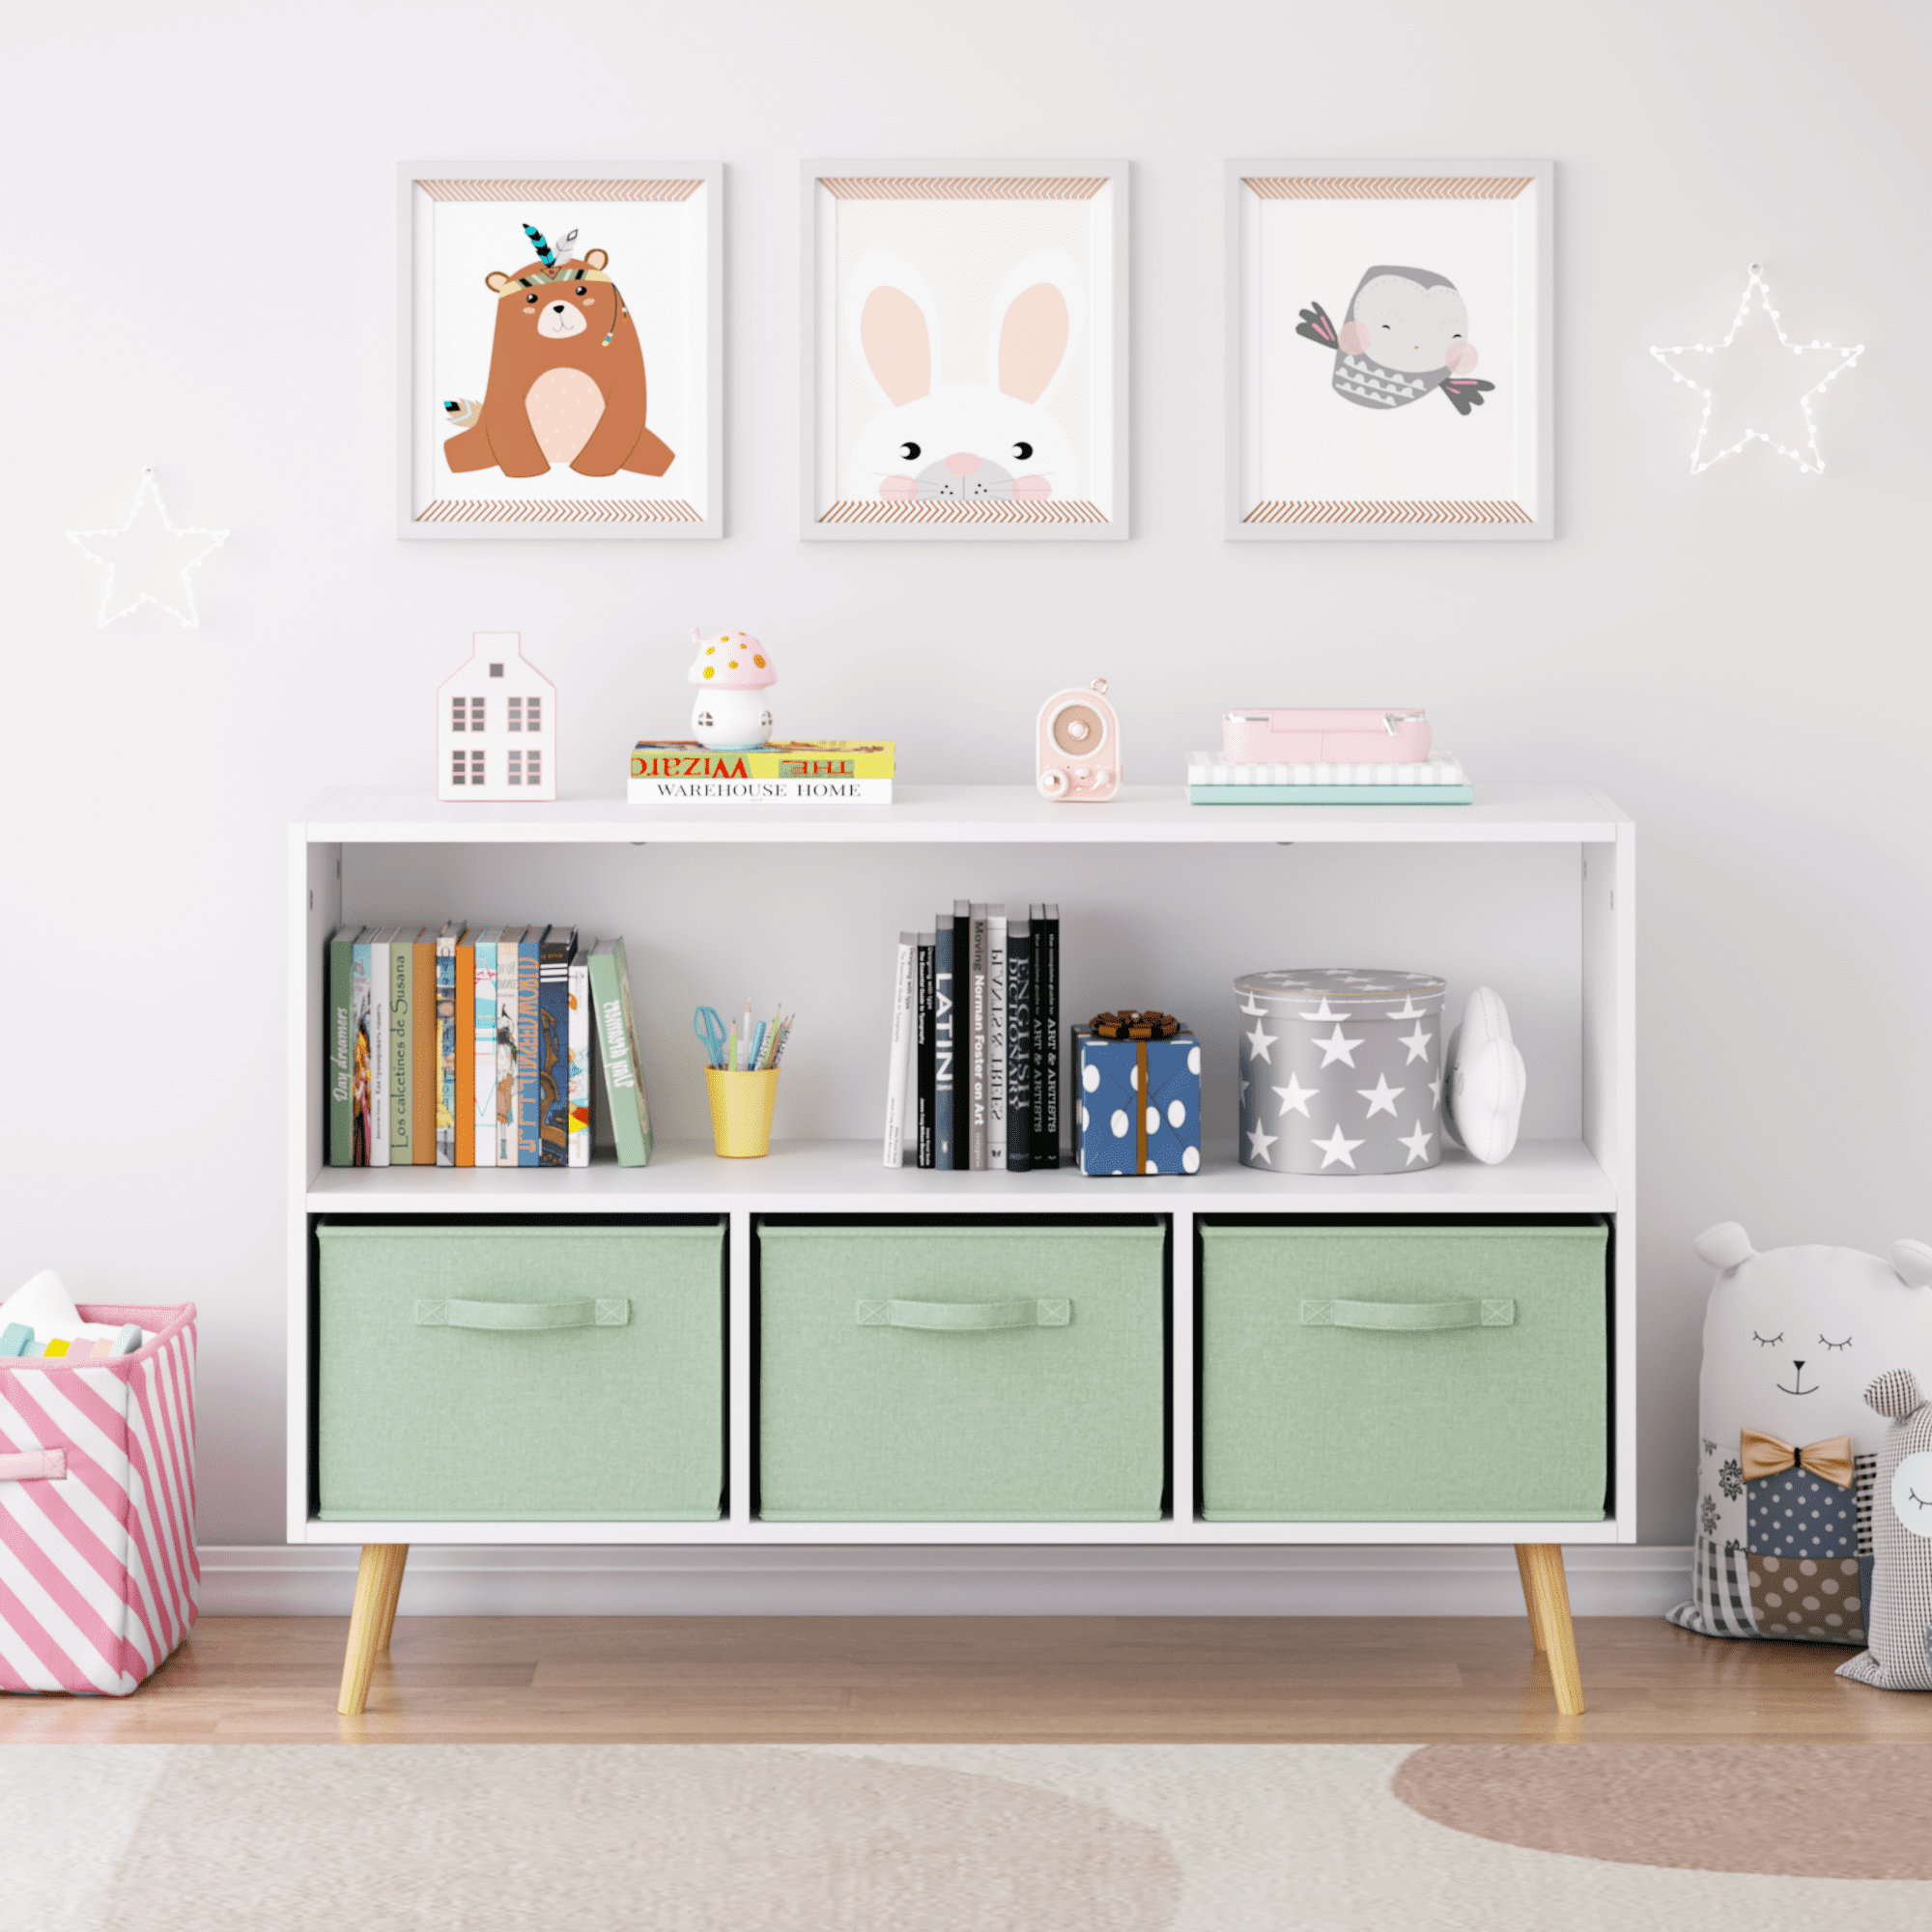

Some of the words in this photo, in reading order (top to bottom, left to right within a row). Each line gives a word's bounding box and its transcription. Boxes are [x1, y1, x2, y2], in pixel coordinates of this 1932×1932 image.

[781, 760, 852, 777] THE
[657, 784, 787, 797] WAREHOUSE
[797, 784, 861, 797] HOME
[973, 921, 984, 972] Moving
[907, 947, 915, 980] Designing
[390, 955, 409, 1015] Susana
[974, 975, 985, 1031] Norman
[330, 1007, 349, 1069] dreamers
[390, 1019, 407, 1037] de
[936, 972, 952, 1081] LATIN
[1009, 957, 1019, 1111] DICTIONARY
[1033, 1018, 1042, 1051] ART
[1048, 1018, 1056, 1051] ART
[974, 1035, 985, 1079] Foster
[1033, 1052, 1042, 1066] &
[1048, 1052, 1056, 1066] &
[332, 1071, 353, 1102] Day
[390, 1040, 407, 1114] calcetines
[974, 1082, 982, 1100] on
[974, 1103, 985, 1125] Art
[1033, 1069, 1042, 1133] ARTISTS
[1048, 1069, 1056, 1133] ARTISTS
[390, 1118, 409, 1149] Los
